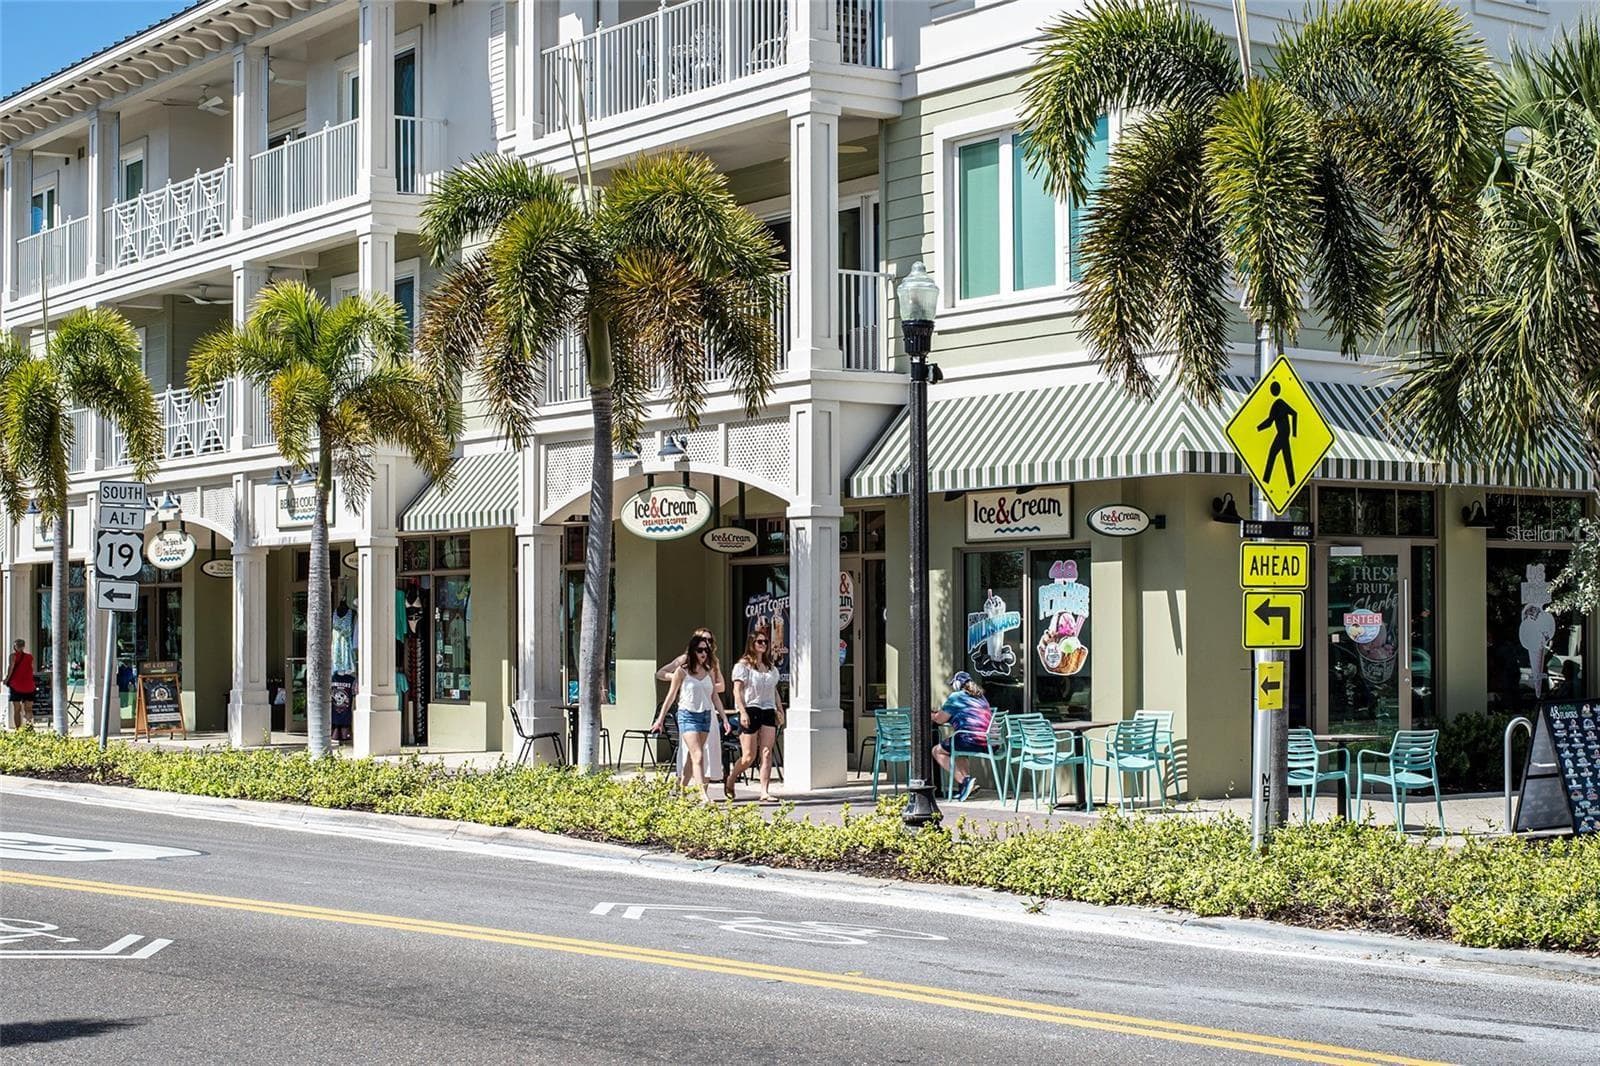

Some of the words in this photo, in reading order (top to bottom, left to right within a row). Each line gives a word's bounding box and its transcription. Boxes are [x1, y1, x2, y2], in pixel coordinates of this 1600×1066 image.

[102, 486, 143, 500] SOUTH
[280, 497, 299, 510] BEACH
[109, 511, 137, 526] ALT
[107, 541, 134, 568] 19
[1249, 555, 1301, 576] AHEAD
[1355, 583, 1391, 594] FRUIT
[745, 600, 768, 618] CRAFT
[767, 596, 790, 614] COFFE
[1345, 615, 1381, 625] ENTER
